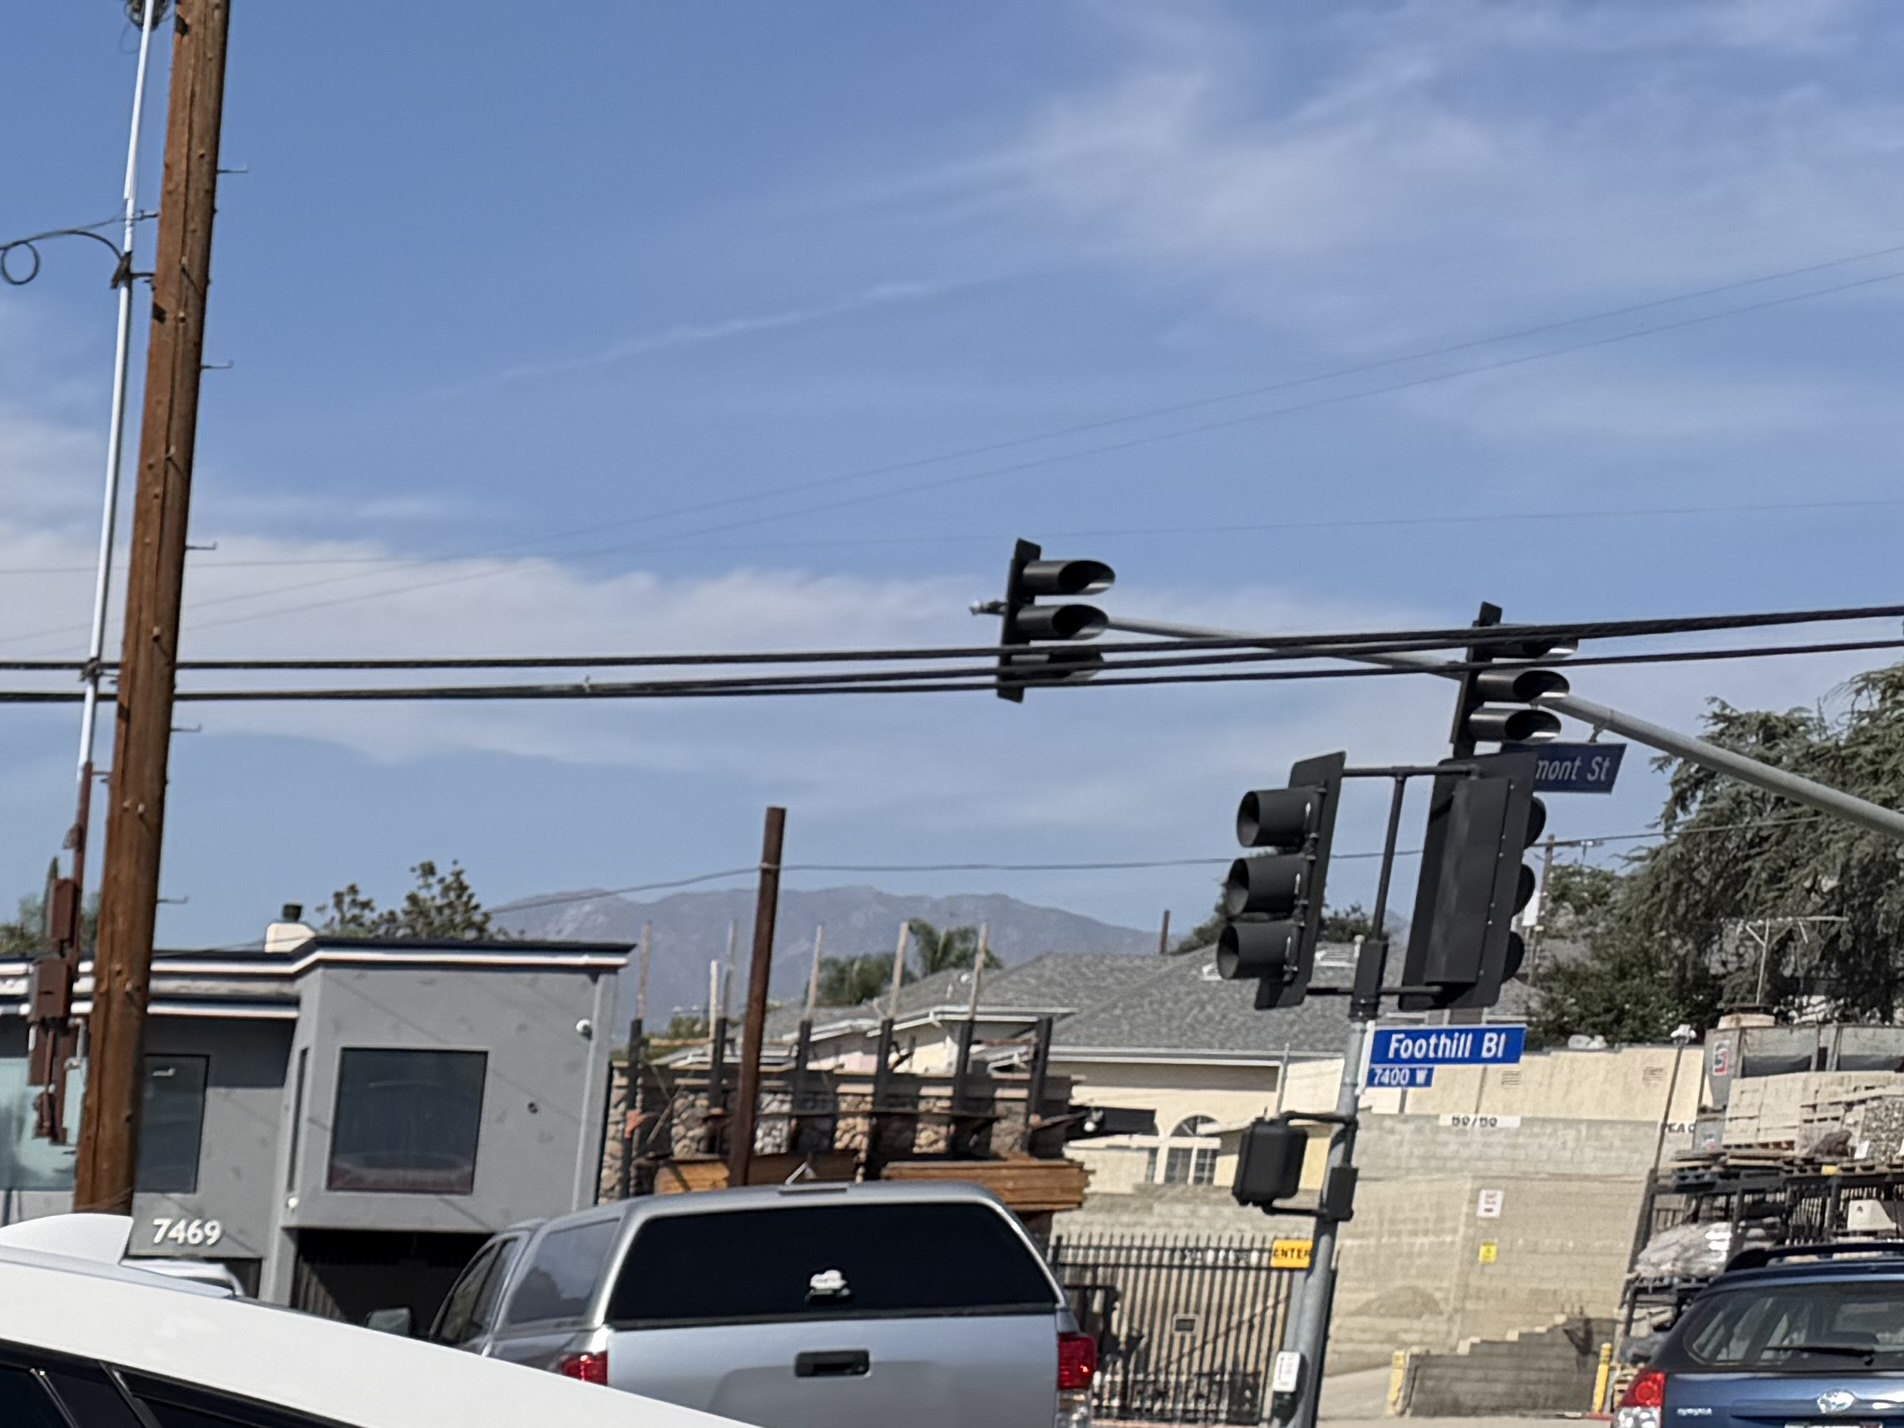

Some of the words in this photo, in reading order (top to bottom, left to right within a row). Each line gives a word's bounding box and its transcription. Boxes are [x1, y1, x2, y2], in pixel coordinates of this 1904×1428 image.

[1536, 756, 1582, 780] mont
[1587, 756, 1610, 781] St
[1388, 1032, 1473, 1059] Foothill
[1481, 1032, 1506, 1058] Bl
[1374, 1069, 1410, 1085] 7400
[1416, 1070, 1428, 1084] W
[153, 1218, 222, 1246] 7469
